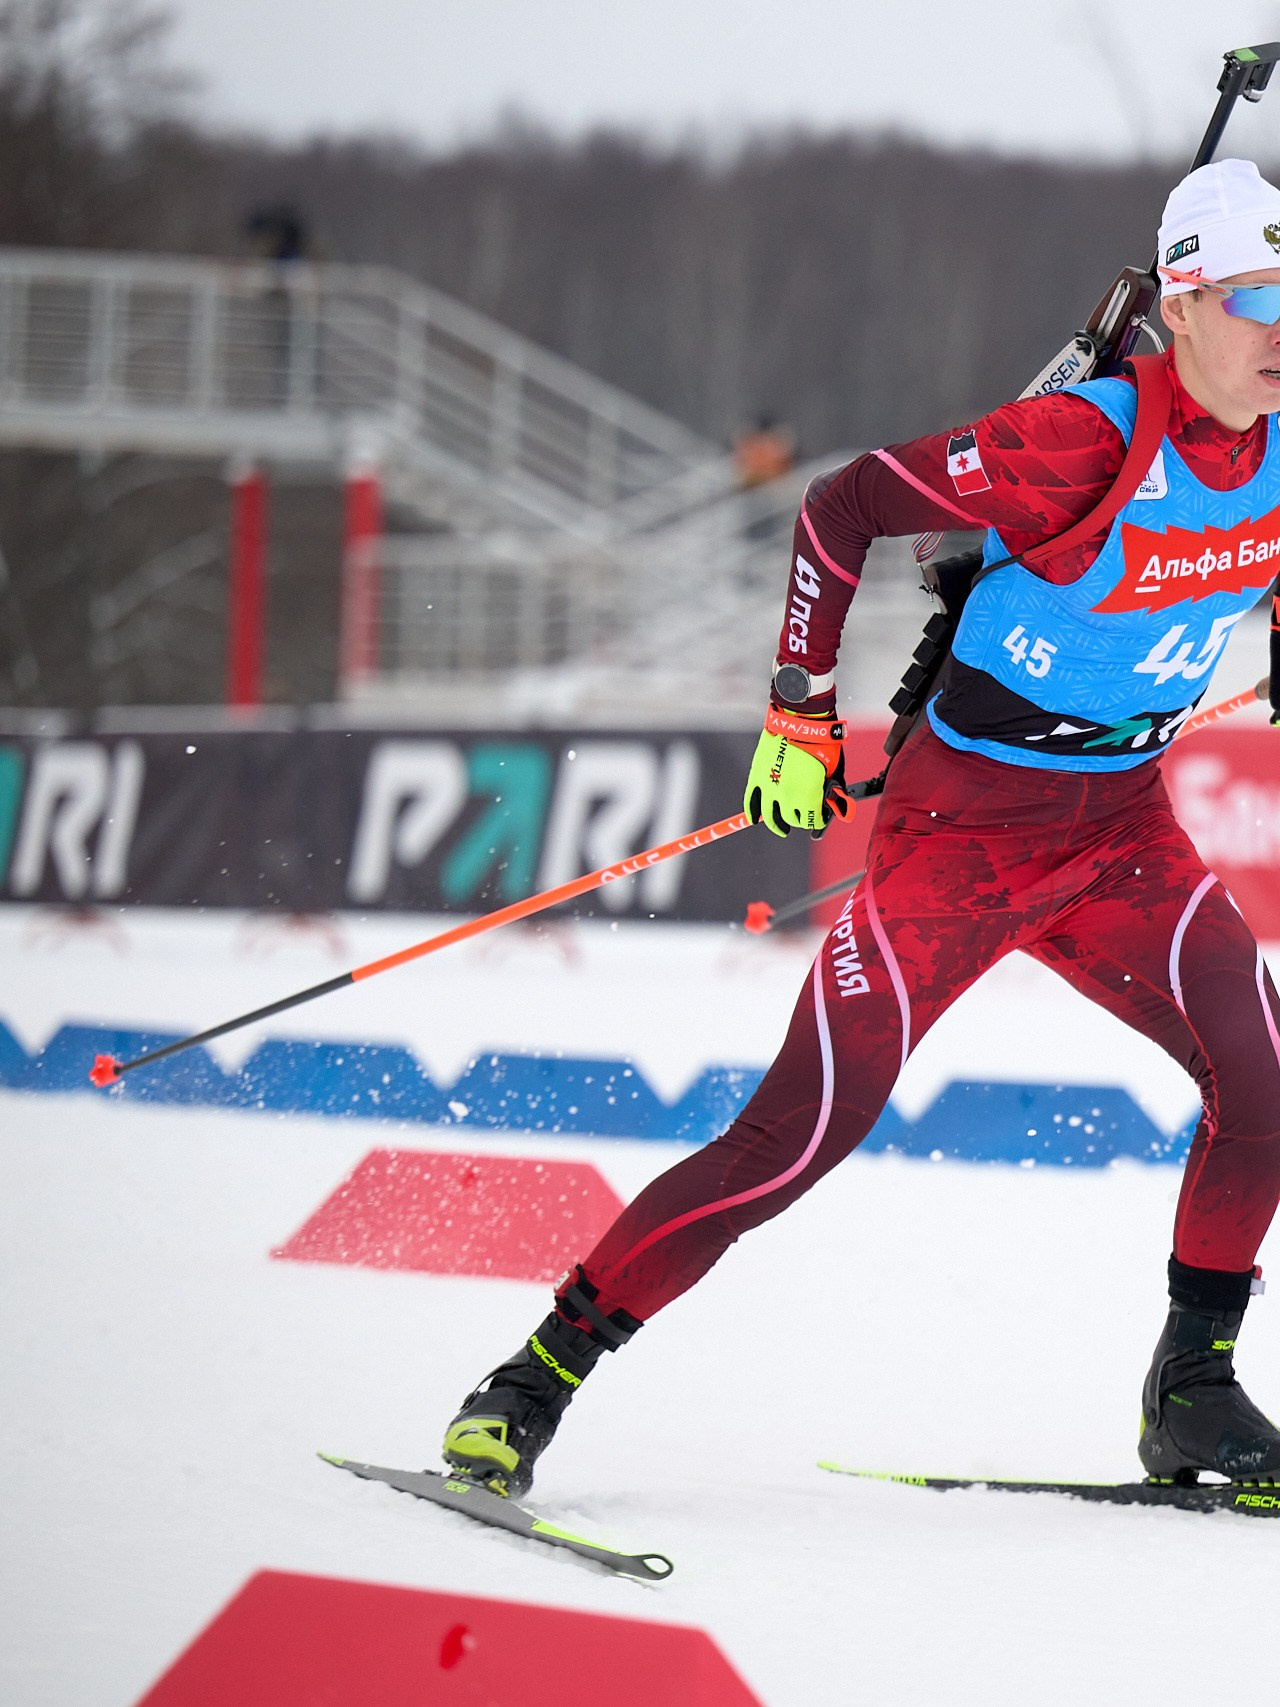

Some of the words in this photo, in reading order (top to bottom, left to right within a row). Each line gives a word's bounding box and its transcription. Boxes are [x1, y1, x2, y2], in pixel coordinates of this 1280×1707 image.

[1166, 237, 1197, 262] PARI
[1138, 548, 1232, 580] Альфа
[788, 594, 812, 654] ПСБ
[1002, 624, 1058, 678] 45
[1132, 609, 1248, 686] 45
[771, 718, 828, 736] ONE/WAY
[346, 742, 699, 908] PARI
